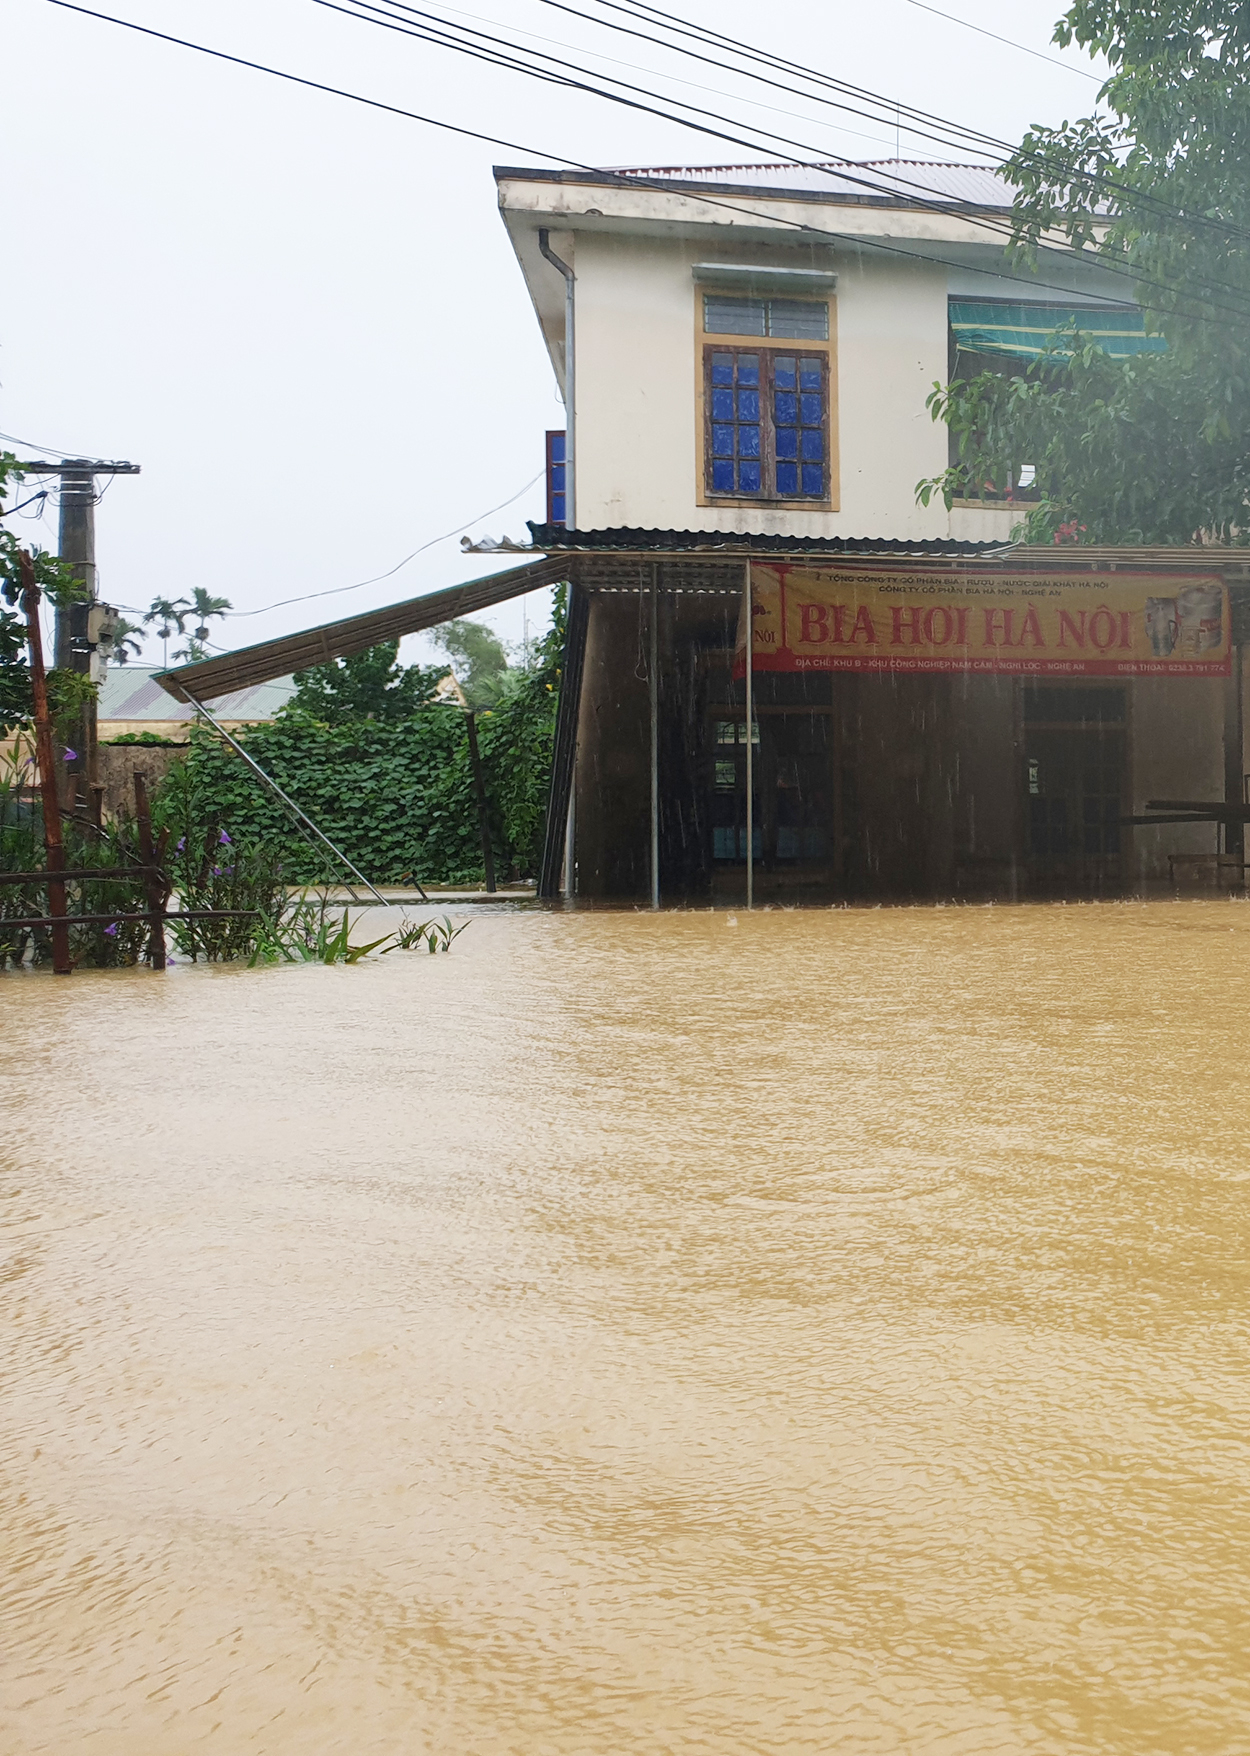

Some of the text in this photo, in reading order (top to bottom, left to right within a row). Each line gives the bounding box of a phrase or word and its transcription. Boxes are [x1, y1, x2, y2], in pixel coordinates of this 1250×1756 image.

[879, 584, 906, 593] CÔNG
[798, 602, 1133, 654] BIA HƠI HÀ NỘI
[833, 659, 853, 667] KHU
[854, 659, 862, 667] B
[868, 659, 887, 668] KHU
[889, 659, 916, 668] CÔNG
[952, 661, 972, 669] NAM
